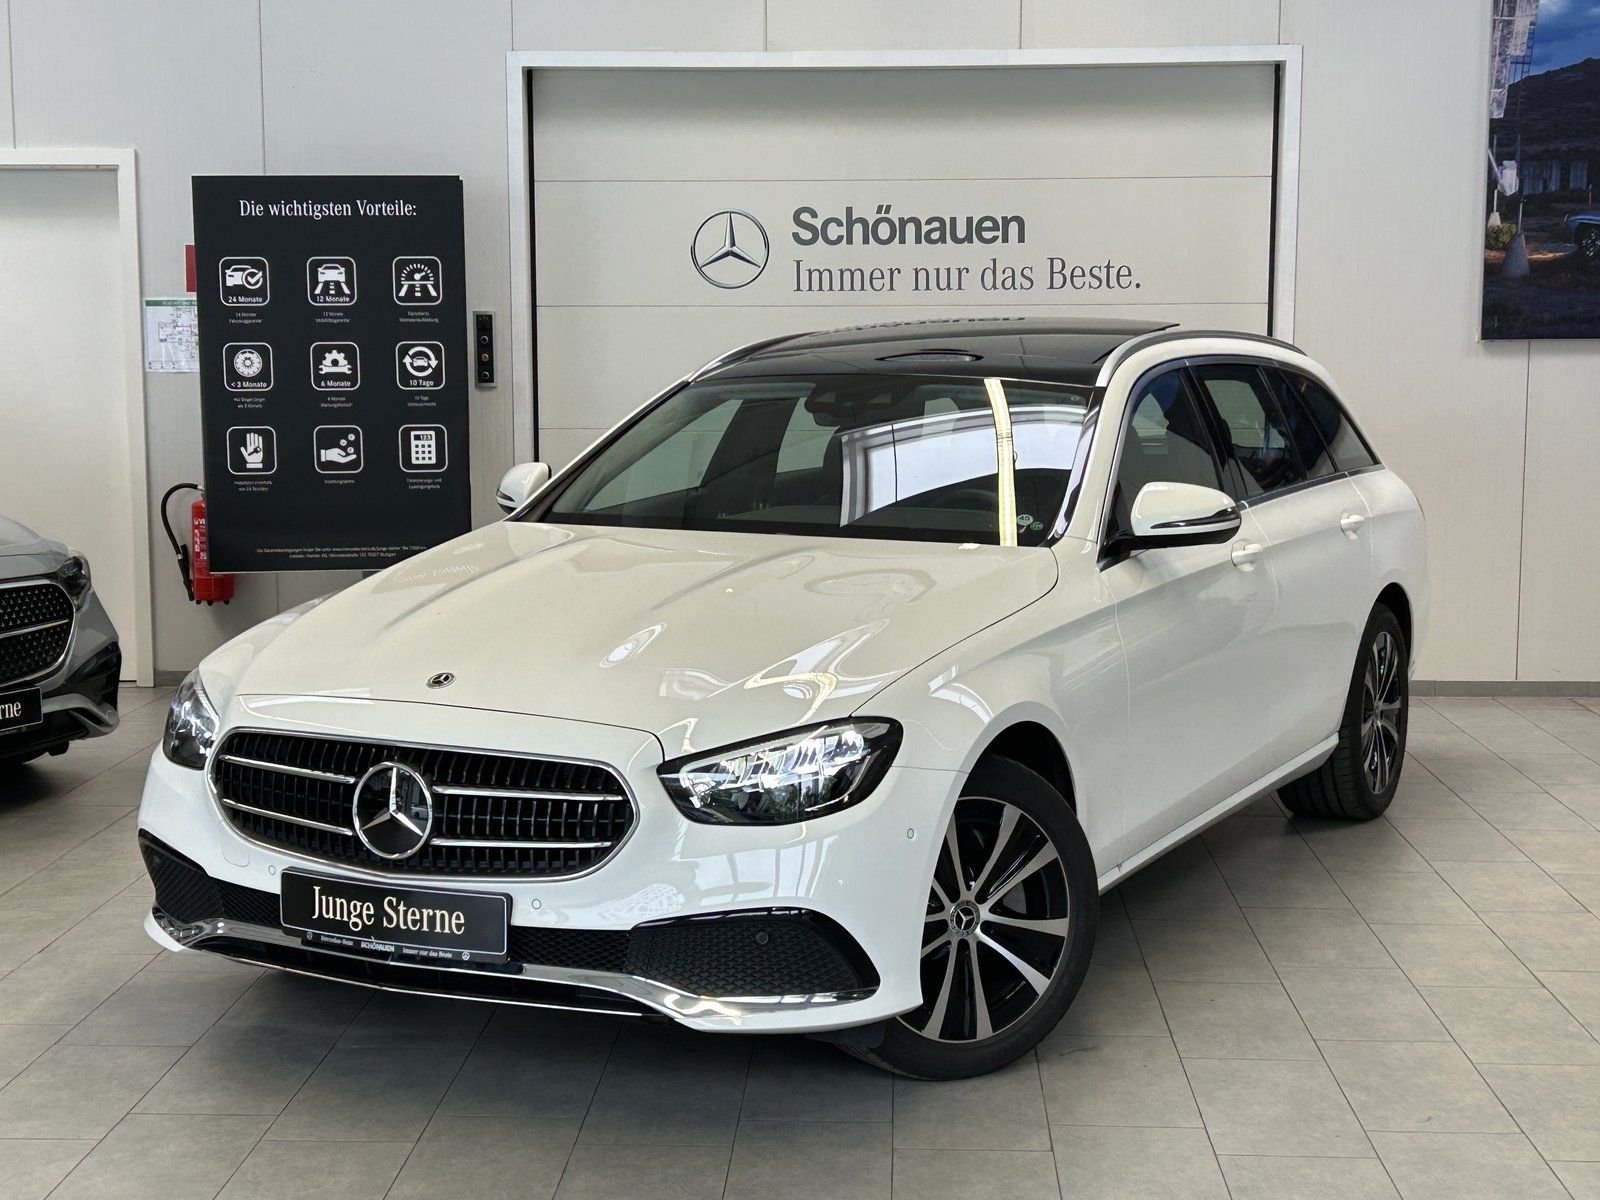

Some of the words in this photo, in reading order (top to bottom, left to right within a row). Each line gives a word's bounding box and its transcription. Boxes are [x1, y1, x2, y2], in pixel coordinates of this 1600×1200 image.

[240, 200, 263, 216] Die
[269, 200, 351, 220] wichtigsten
[356, 200, 416, 217] Vorteile:
[792, 204, 1025, 246] Schönauen
[793, 260, 901, 292] Immer
[911, 266, 970, 292] nur
[981, 259, 1035, 291] das
[1047, 258, 1140, 290] Beste.
[316, 295, 324, 303] 12
[325, 295, 350, 303] Monate
[409, 379, 417, 387] 10
[417, 379, 434, 388] Tage
[312, 886, 374, 931] Junge
[383, 897, 465, 935] Sterne
